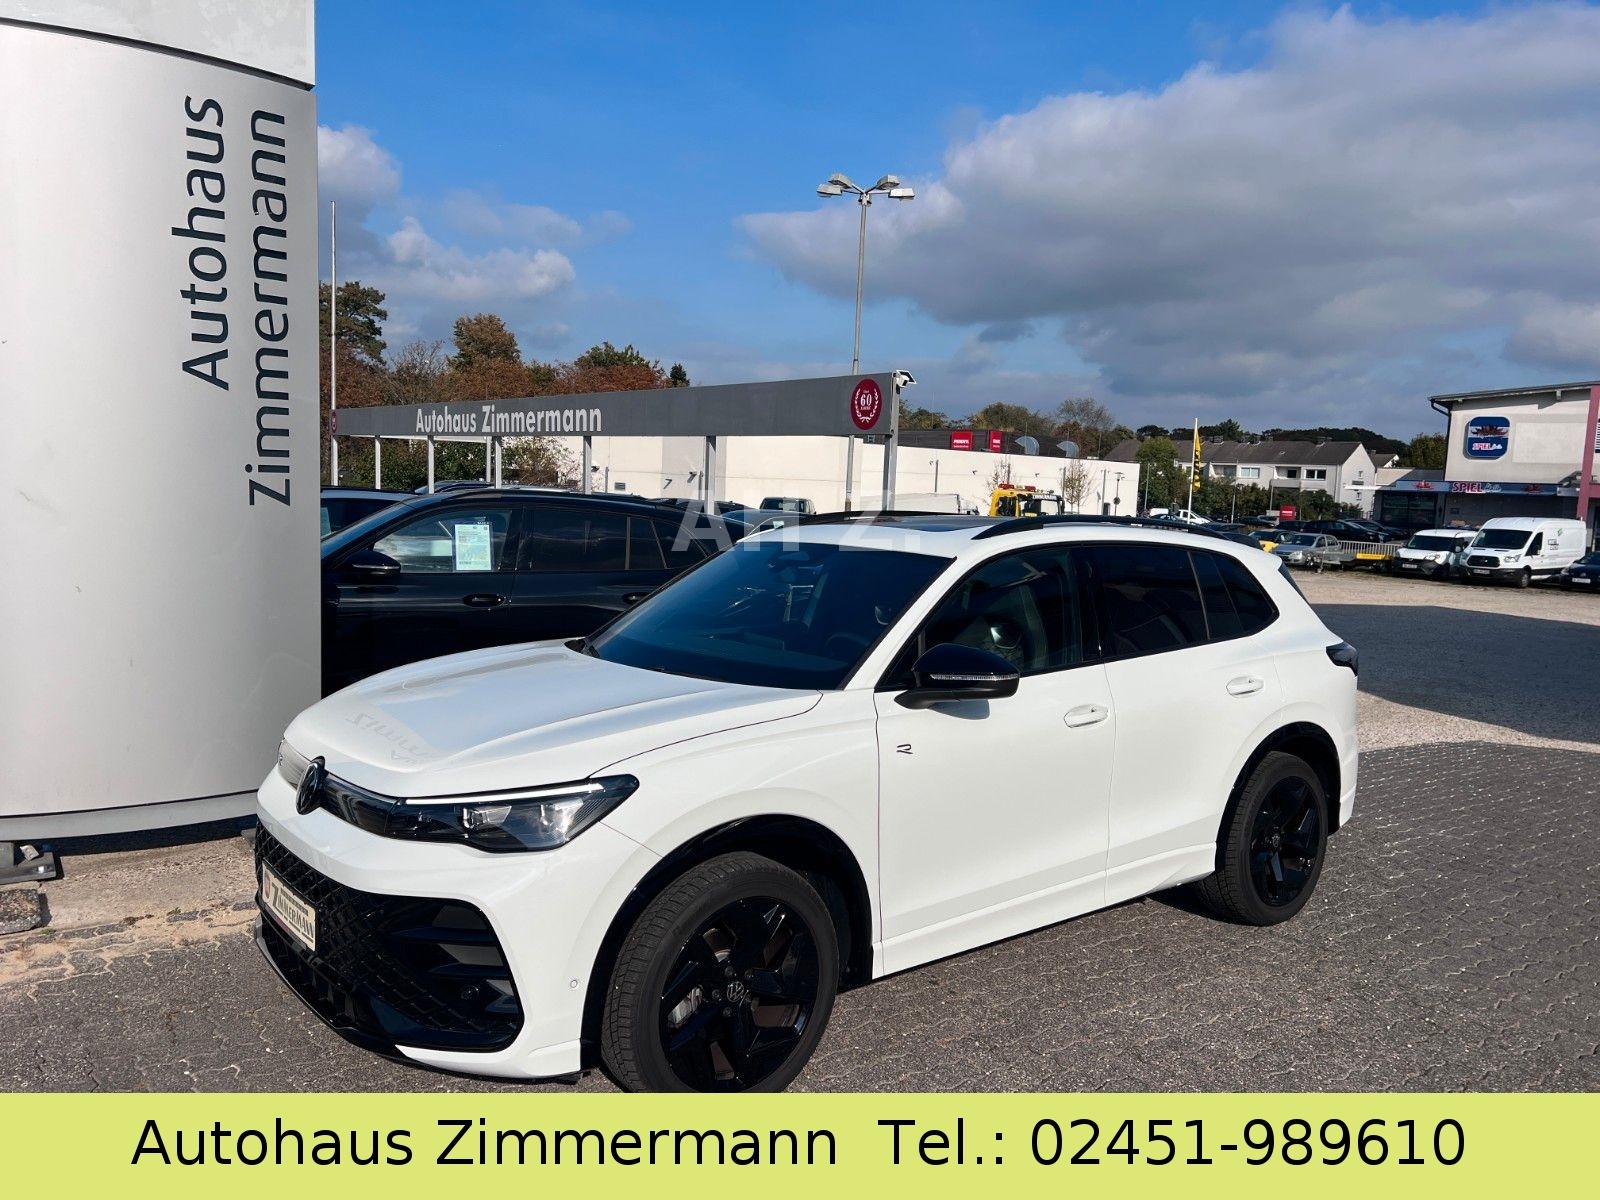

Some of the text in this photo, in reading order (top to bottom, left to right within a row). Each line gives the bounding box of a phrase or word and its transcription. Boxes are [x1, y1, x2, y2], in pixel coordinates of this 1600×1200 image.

[171, 95, 229, 391] Autohaus
[245, 109, 291, 506] Zimmermann
[860, 393, 872, 406] 60
[415, 404, 602, 433] Autohaus Zimmermann
[1452, 482, 1484, 493] SPIEL
